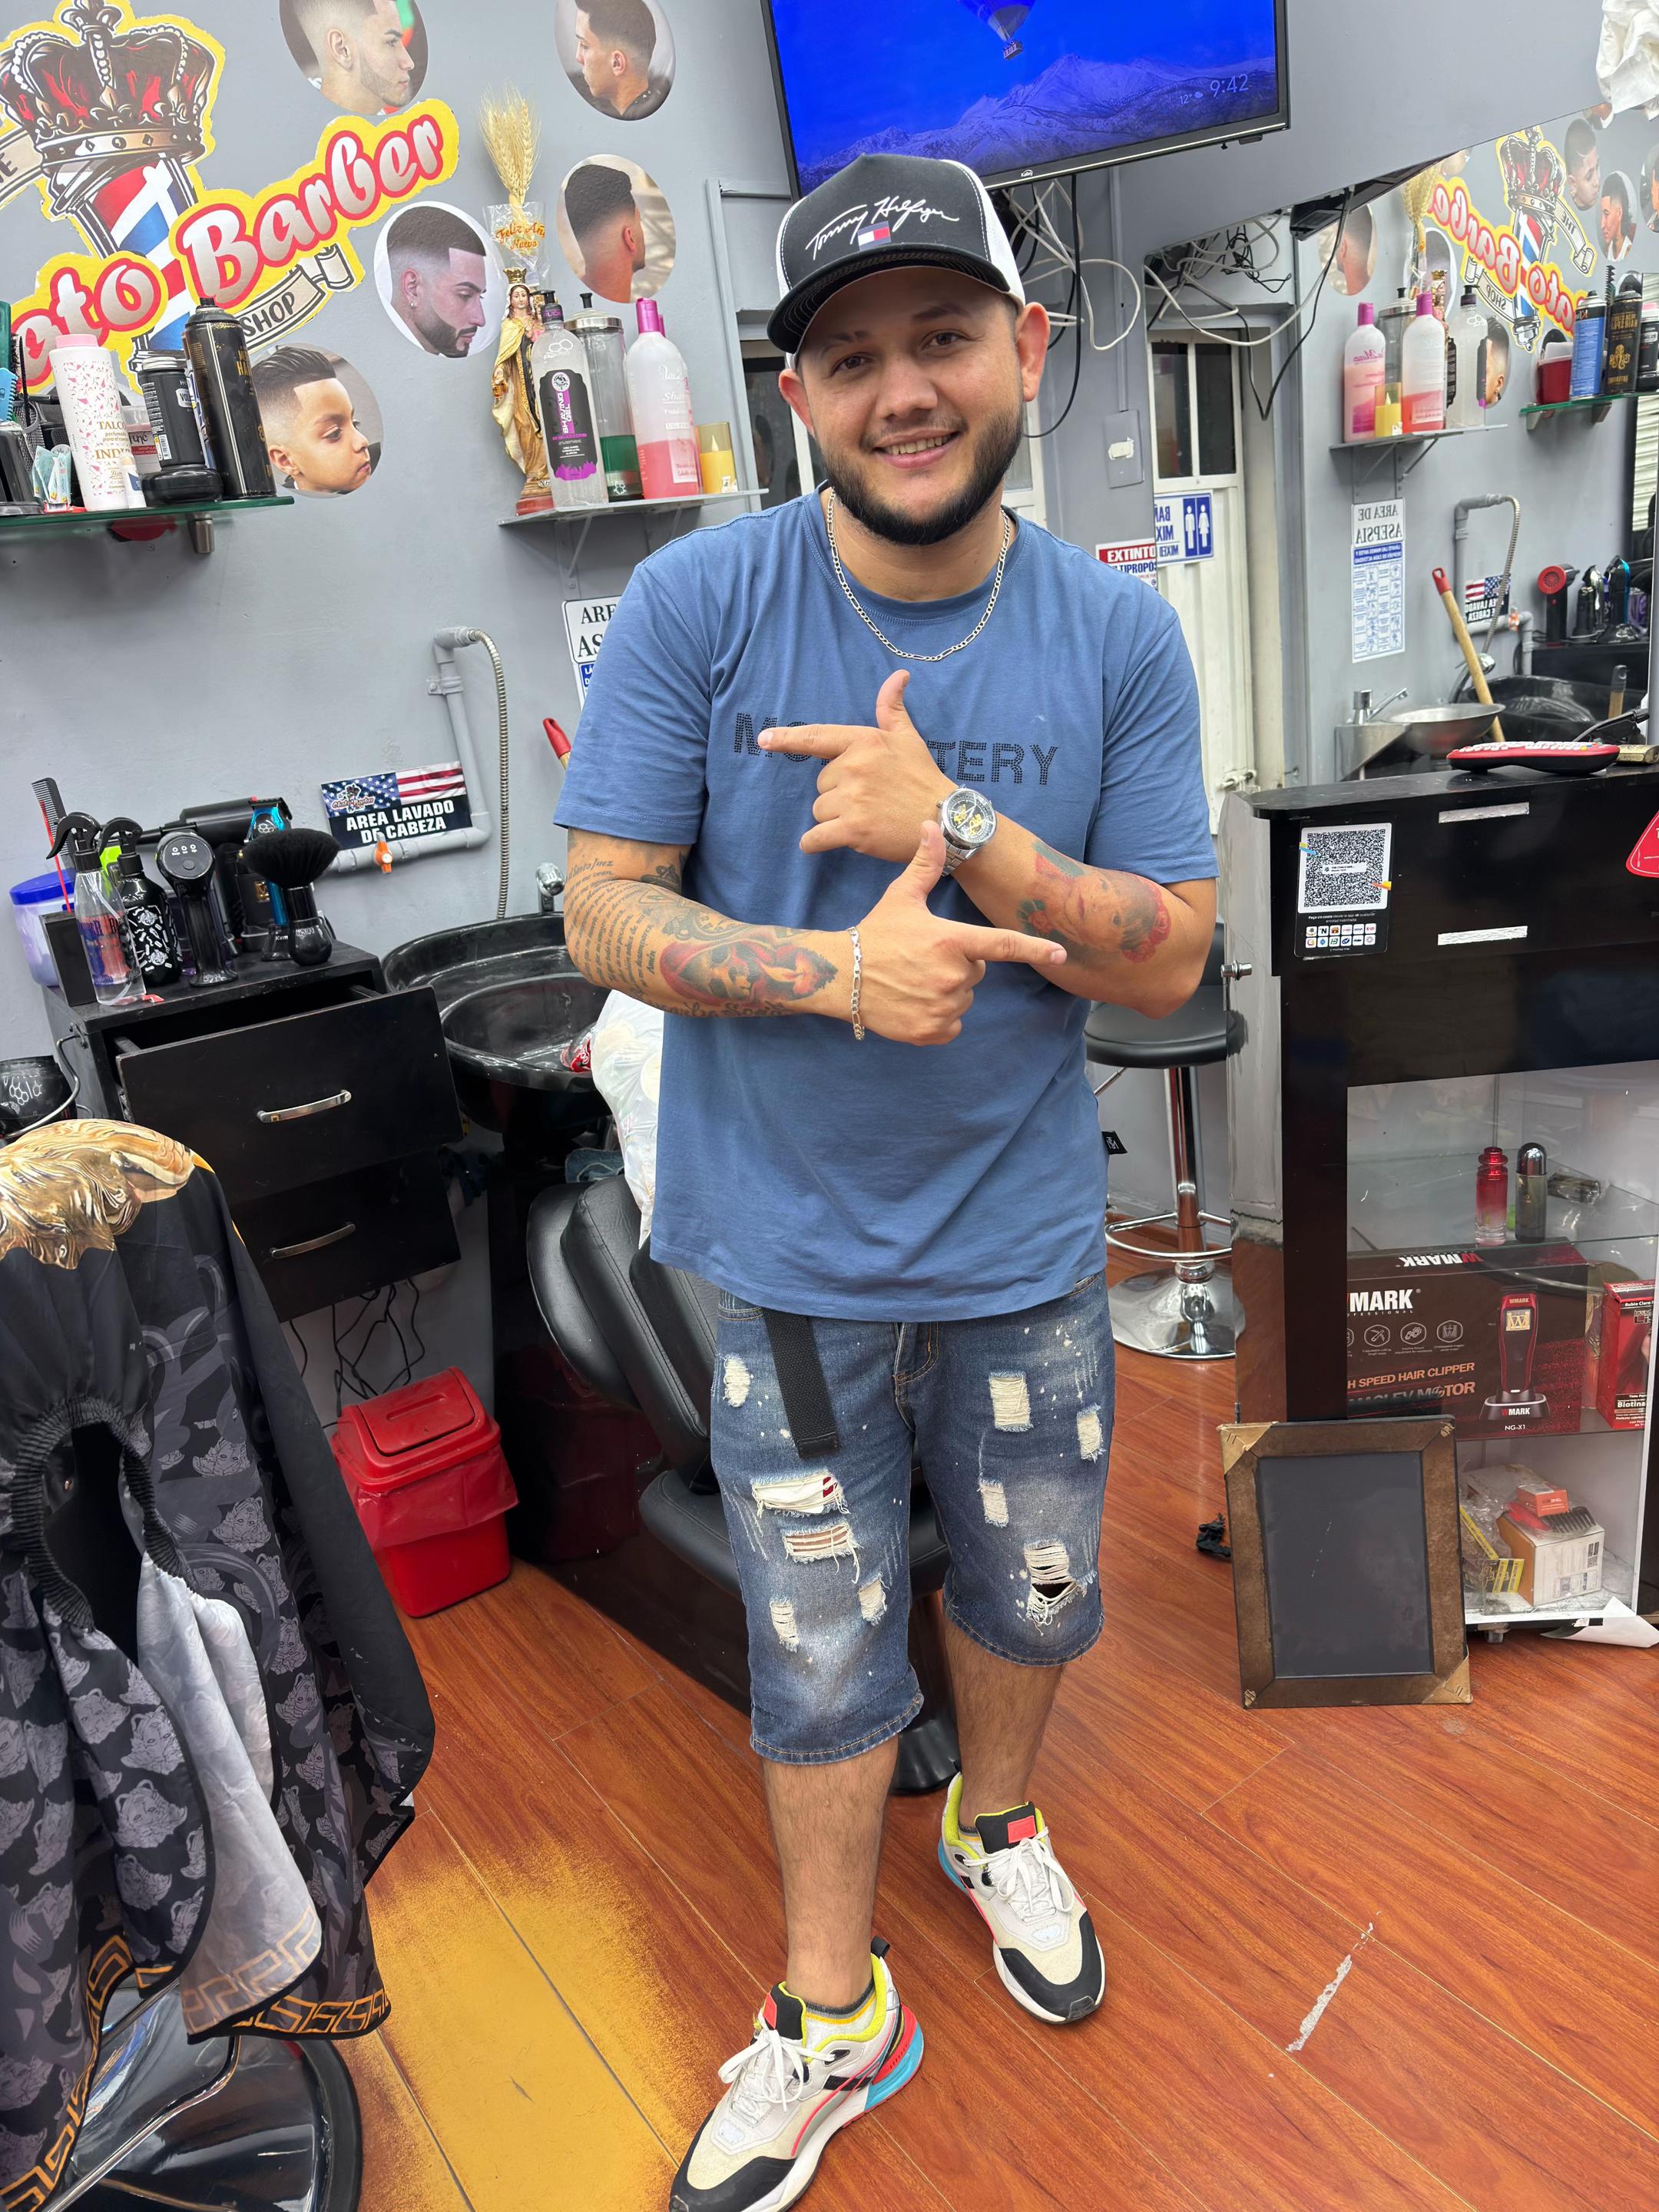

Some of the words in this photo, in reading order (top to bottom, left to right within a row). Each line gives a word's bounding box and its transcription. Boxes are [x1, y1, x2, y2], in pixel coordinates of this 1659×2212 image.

[1210, 74, 1249, 98] 9:42
[175, 114, 444, 309] Barber
[805, 204, 869, 260] Tommy
[239, 291, 295, 337] SHOP
[557, 392, 569, 434] SHAVING
[565, 402, 573, 422] GEL
[346, 811, 389, 831] AREA
[392, 800, 455, 823] LAVADO
[386, 816, 447, 839] CABEZA
[1398, 1252, 1485, 1267] WMARK
[1347, 1289, 1413, 1313] MARK
[1358, 1374, 1396, 1388] SPEED
[1398, 1369, 1425, 1382] HAIR
[1427, 1362, 1475, 1377] CLIPPER
[1502, 1407, 1531, 1416] WMARK
